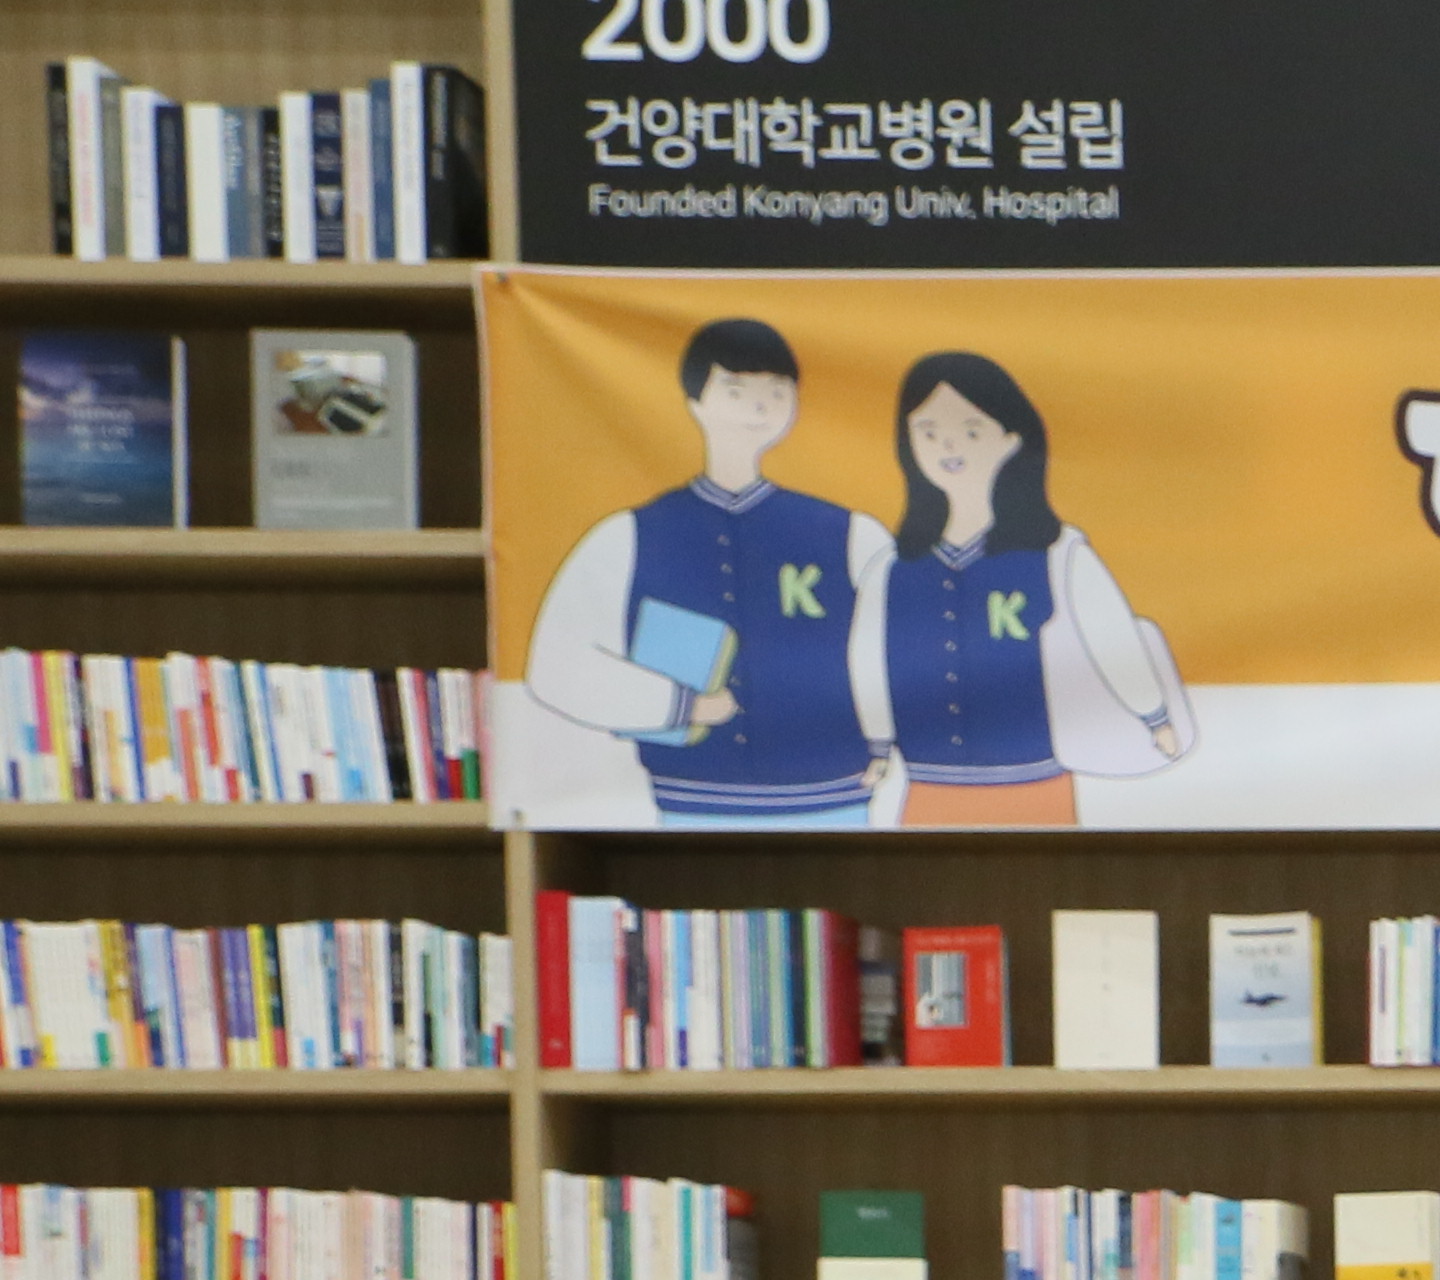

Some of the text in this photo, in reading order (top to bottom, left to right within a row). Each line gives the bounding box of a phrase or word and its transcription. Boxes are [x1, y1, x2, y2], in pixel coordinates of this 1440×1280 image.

[581, 0, 832, 64] 2000
[584, 97, 1125, 170] 건양대학교병원 설립
[589, 184, 1120, 226] Founded Konyang Univ. Hospital
[779, 563, 826, 619] K
[987, 591, 1031, 641] K
